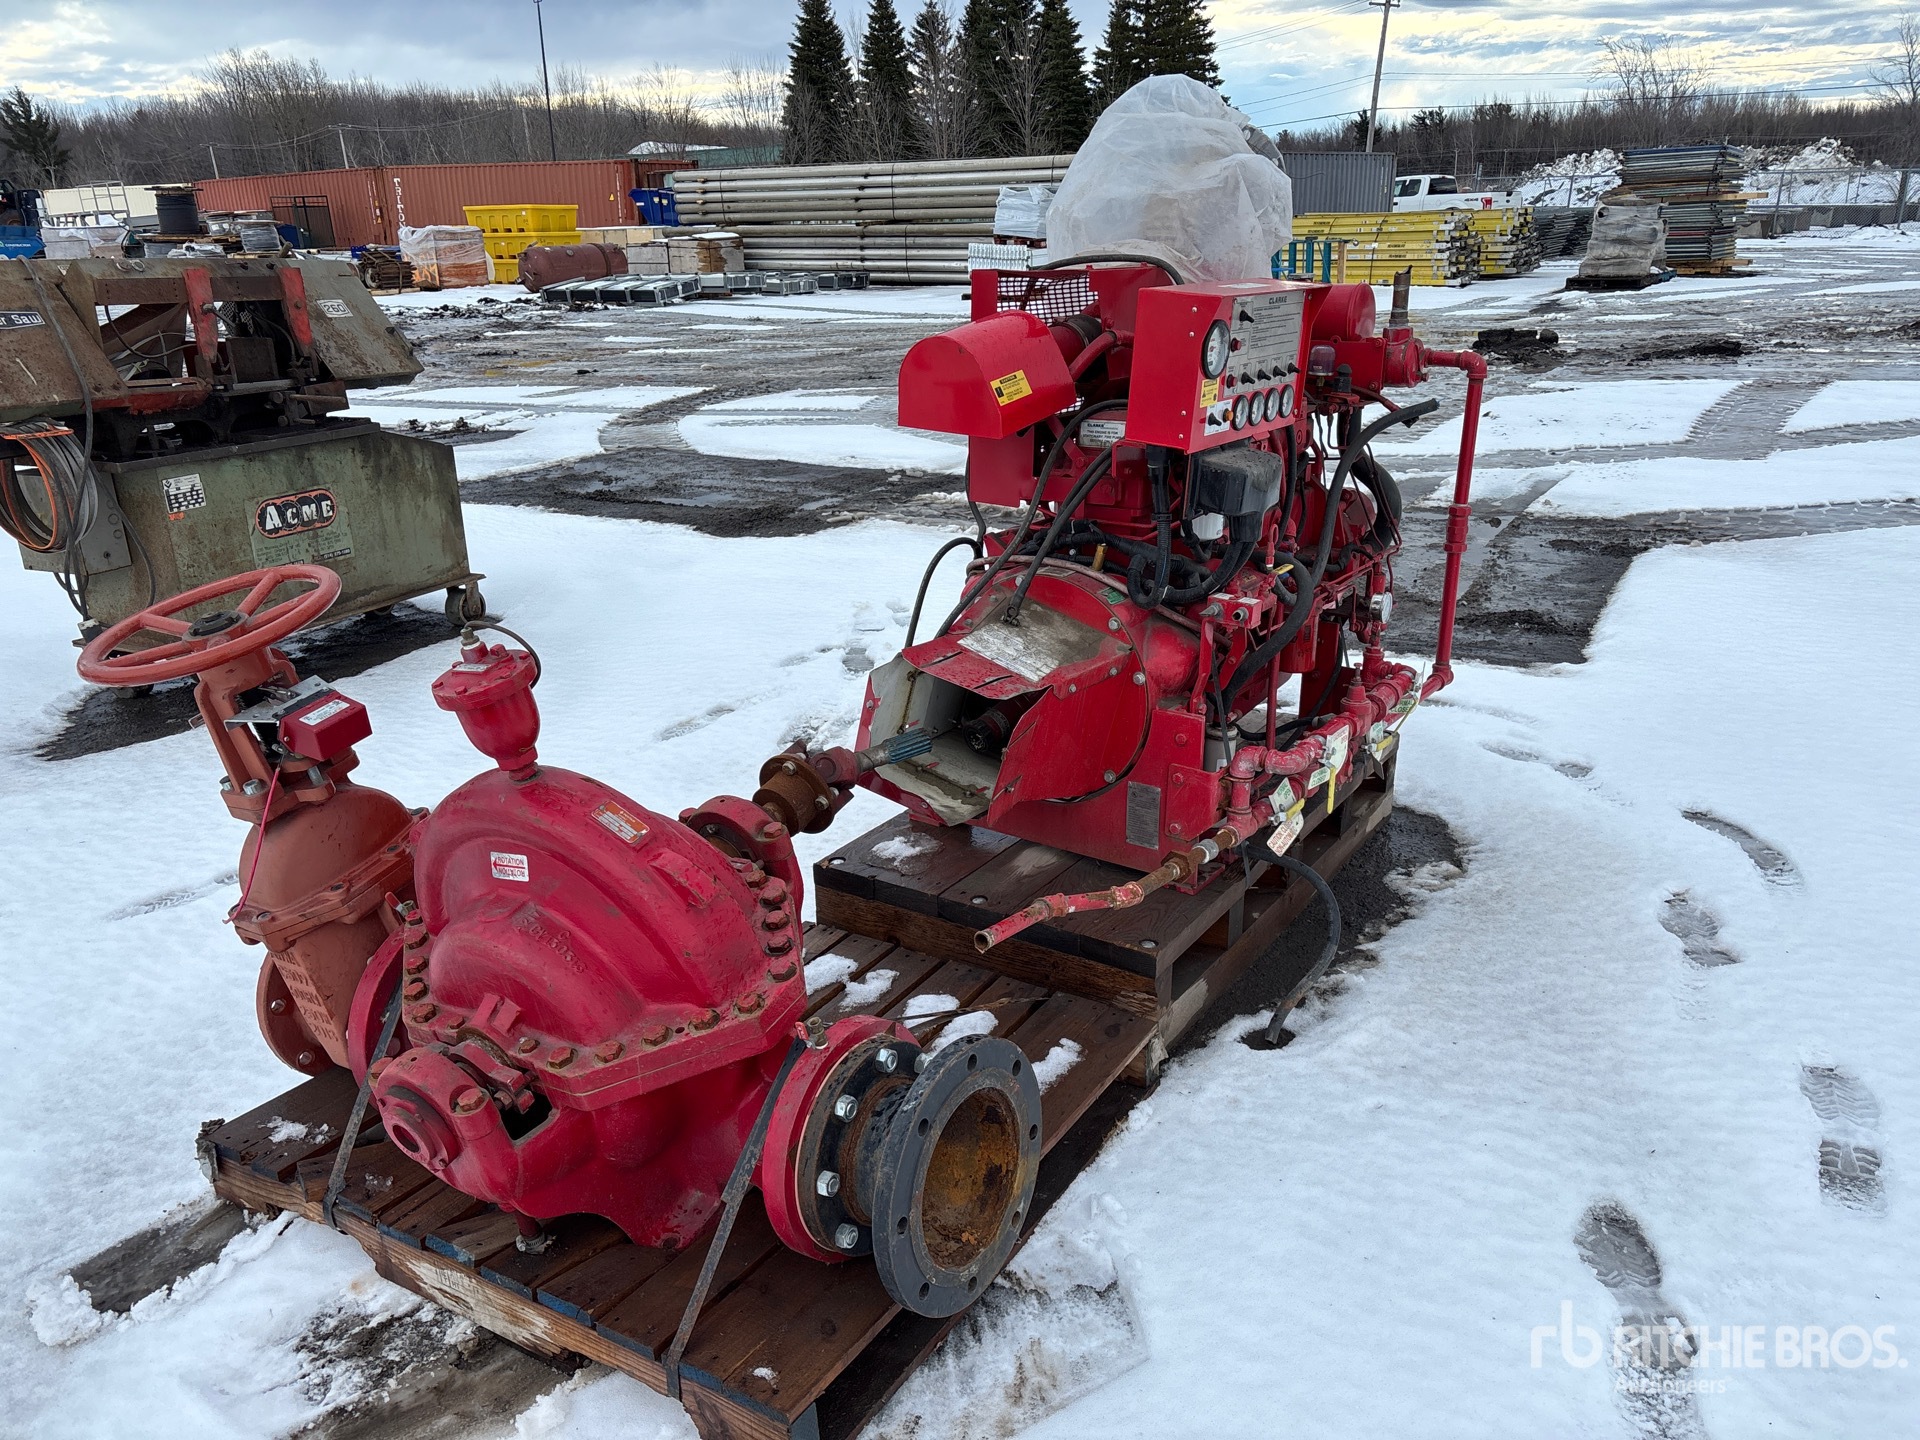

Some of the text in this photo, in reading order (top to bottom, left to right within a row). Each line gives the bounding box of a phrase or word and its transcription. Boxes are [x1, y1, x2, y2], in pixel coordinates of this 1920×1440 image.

[1268, 295, 1288, 305] CLARKE
[323, 304, 346, 313] 260
[11, 314, 42, 324] Saw
[264, 499, 334, 531] ACME
[497, 856, 525, 866] ROTATION
